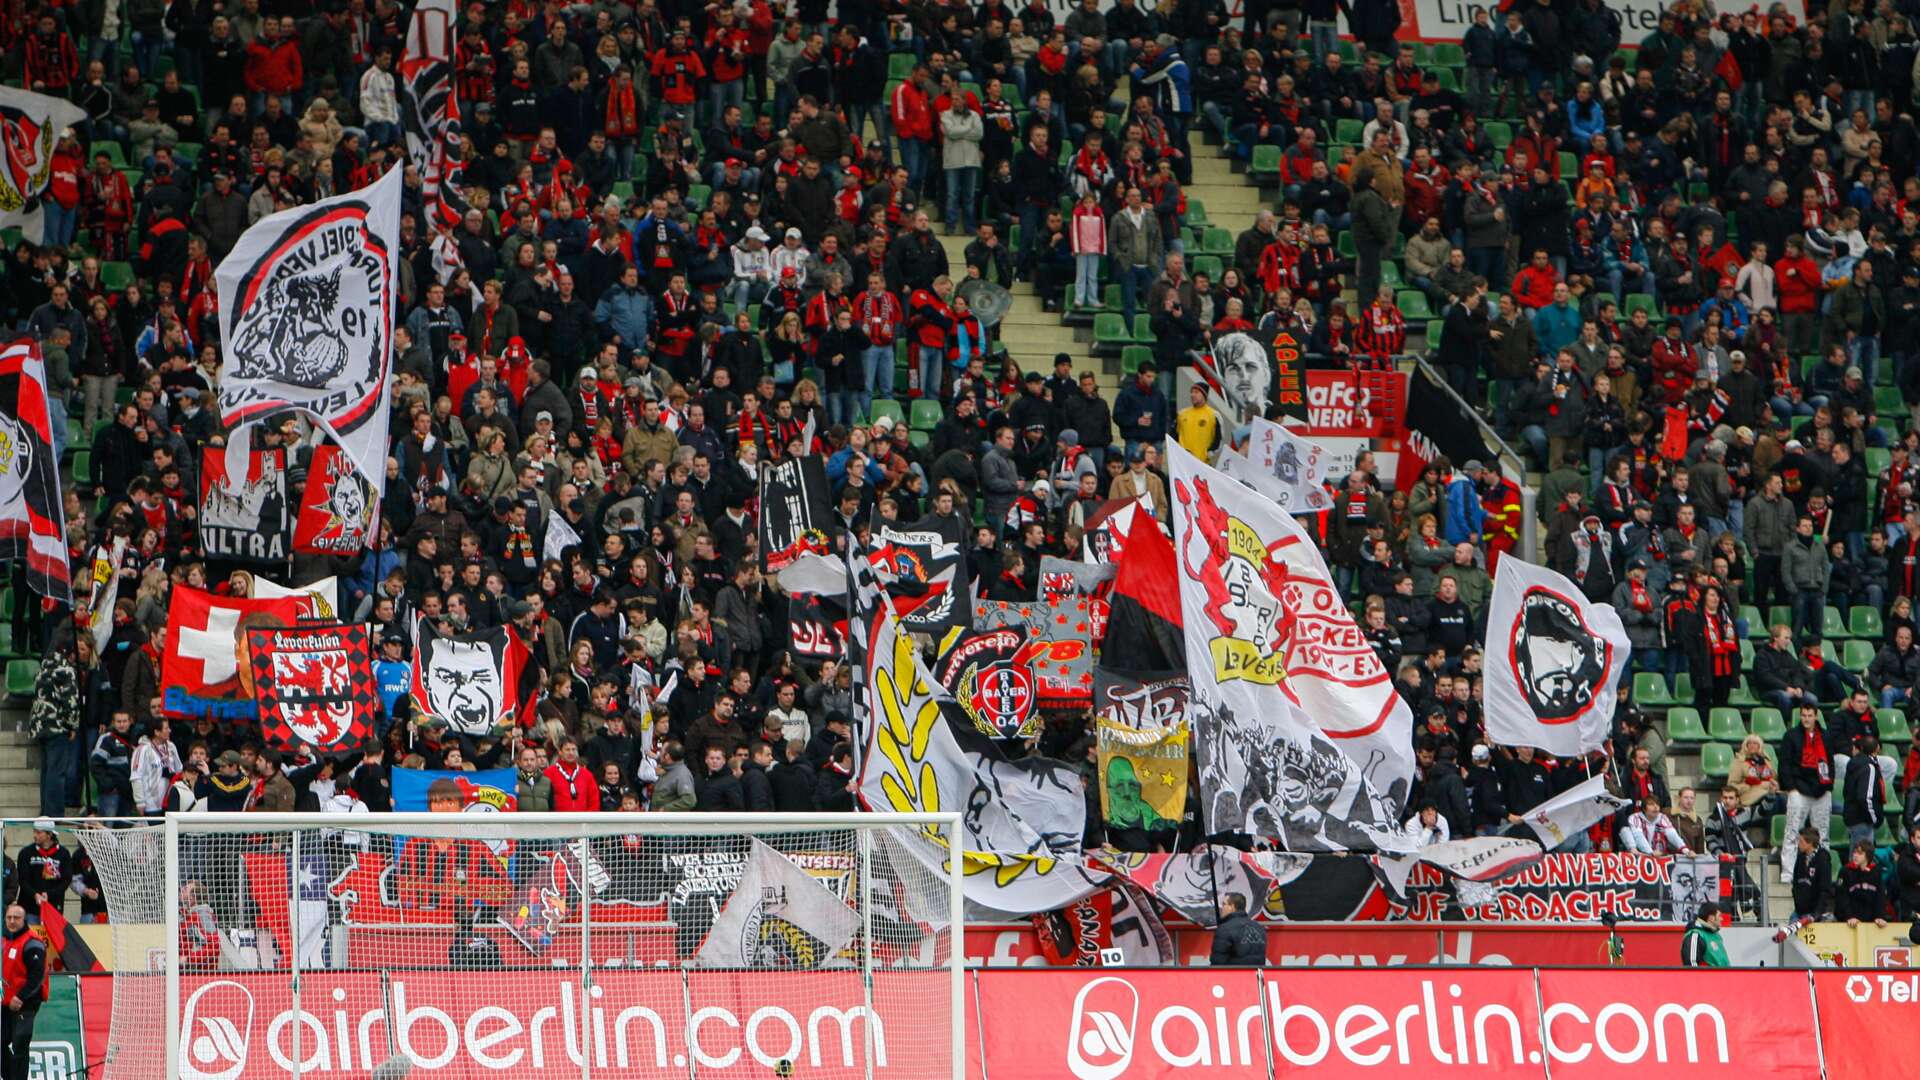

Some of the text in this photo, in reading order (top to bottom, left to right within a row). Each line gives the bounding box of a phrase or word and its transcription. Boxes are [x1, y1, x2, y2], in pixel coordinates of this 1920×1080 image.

[1272, 332, 1303, 405] ADLER
[200, 527, 284, 559] ULTRA
[1232, 527, 1262, 561] 1904
[984, 688, 1026, 697] BAYER
[999, 672, 1011, 714] BAYER
[995, 714, 1019, 727] 04
[1102, 952, 1122, 964] 10
[267, 981, 887, 1070] airberlin.com
[1151, 979, 1730, 1067] airberlin.com
